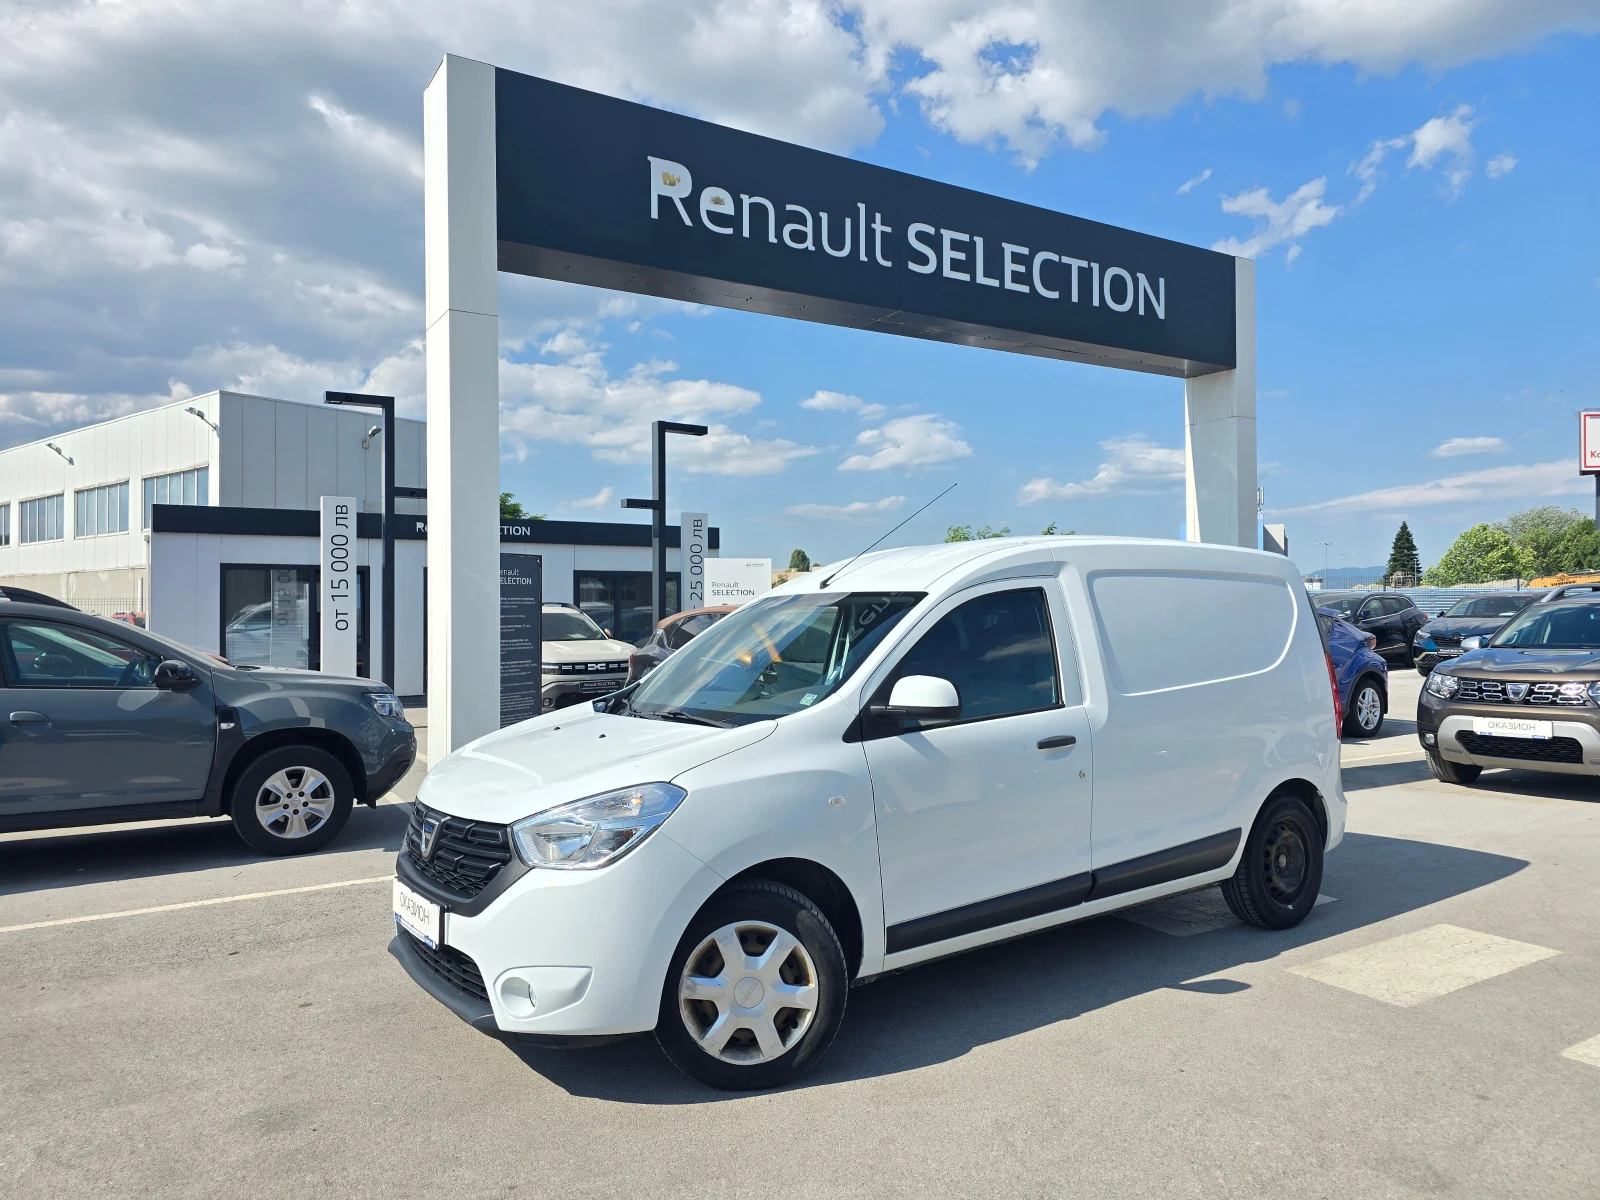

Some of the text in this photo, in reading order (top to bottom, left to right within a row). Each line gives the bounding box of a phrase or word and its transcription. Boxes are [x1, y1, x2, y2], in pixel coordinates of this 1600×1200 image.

[647, 155, 1165, 320] Renault SELECTION
[500, 526, 531, 536] TION
[331, 534, 349, 573] 000
[690, 543, 703, 576] 000
[500, 568, 519, 576] enault
[500, 577, 532, 585] ELECTION
[331, 579, 349, 602] 15
[690, 581, 703, 601] 25
[1487, 720, 1536, 731] ОКАЗИОН
[400, 891, 430, 925] ОКАЗИОН
